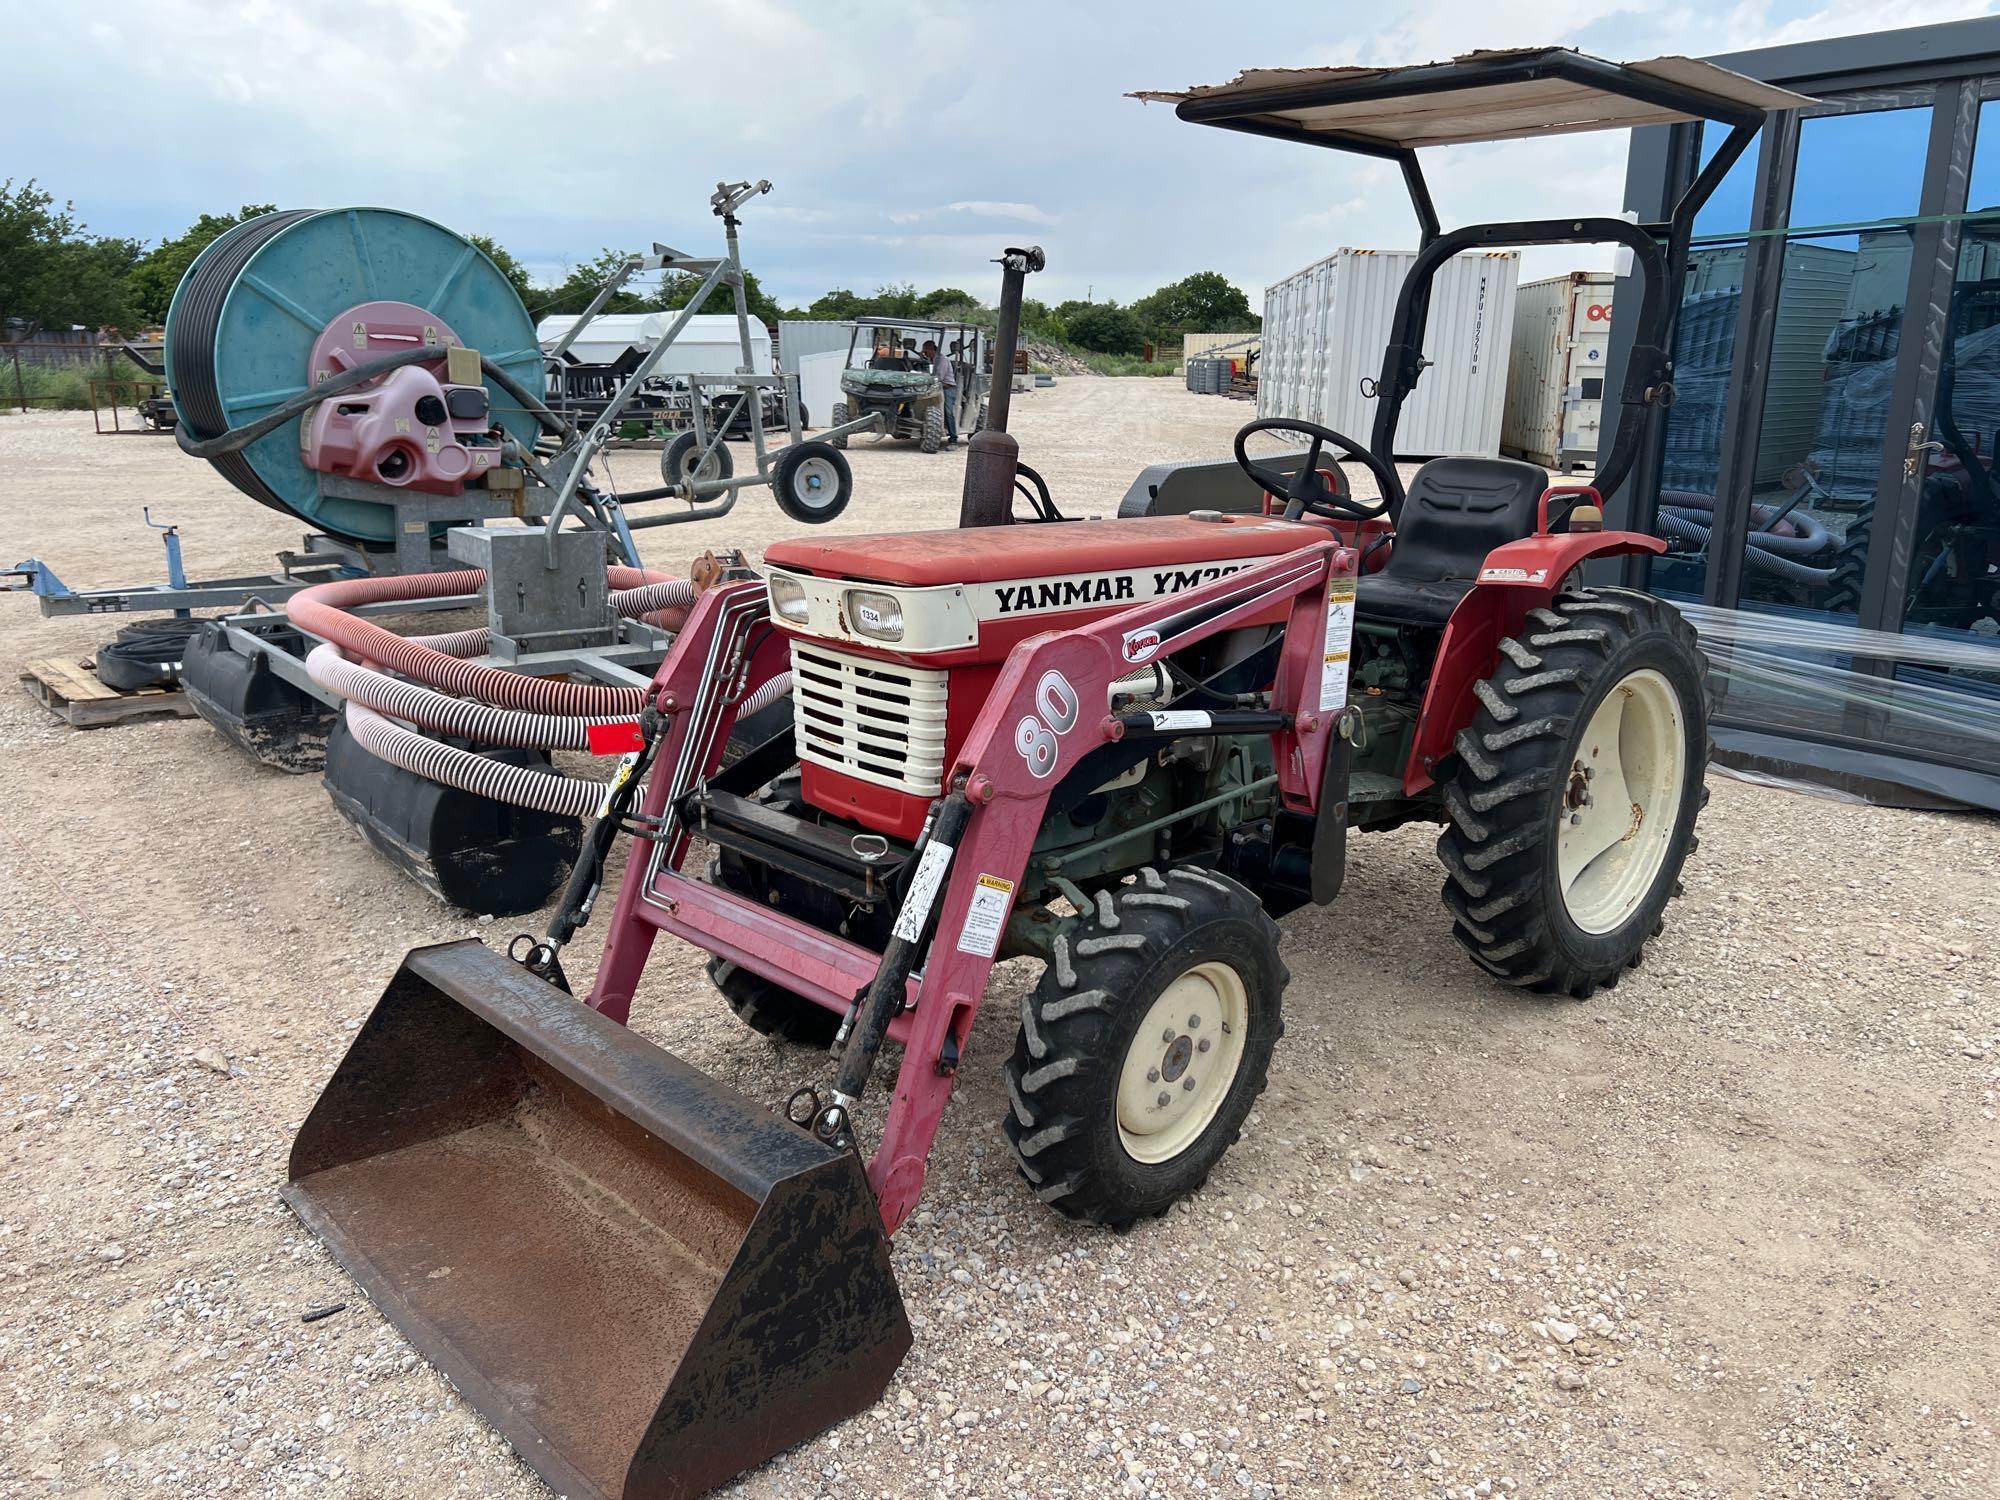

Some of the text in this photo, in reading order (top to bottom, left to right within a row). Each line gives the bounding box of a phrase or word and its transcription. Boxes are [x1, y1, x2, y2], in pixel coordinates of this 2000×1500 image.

[995, 564, 1255, 613] YANMAR YM2
[862, 609, 879, 622] 1334
[1015, 669, 1079, 778] 80
[986, 877, 1011, 890] WARNING
